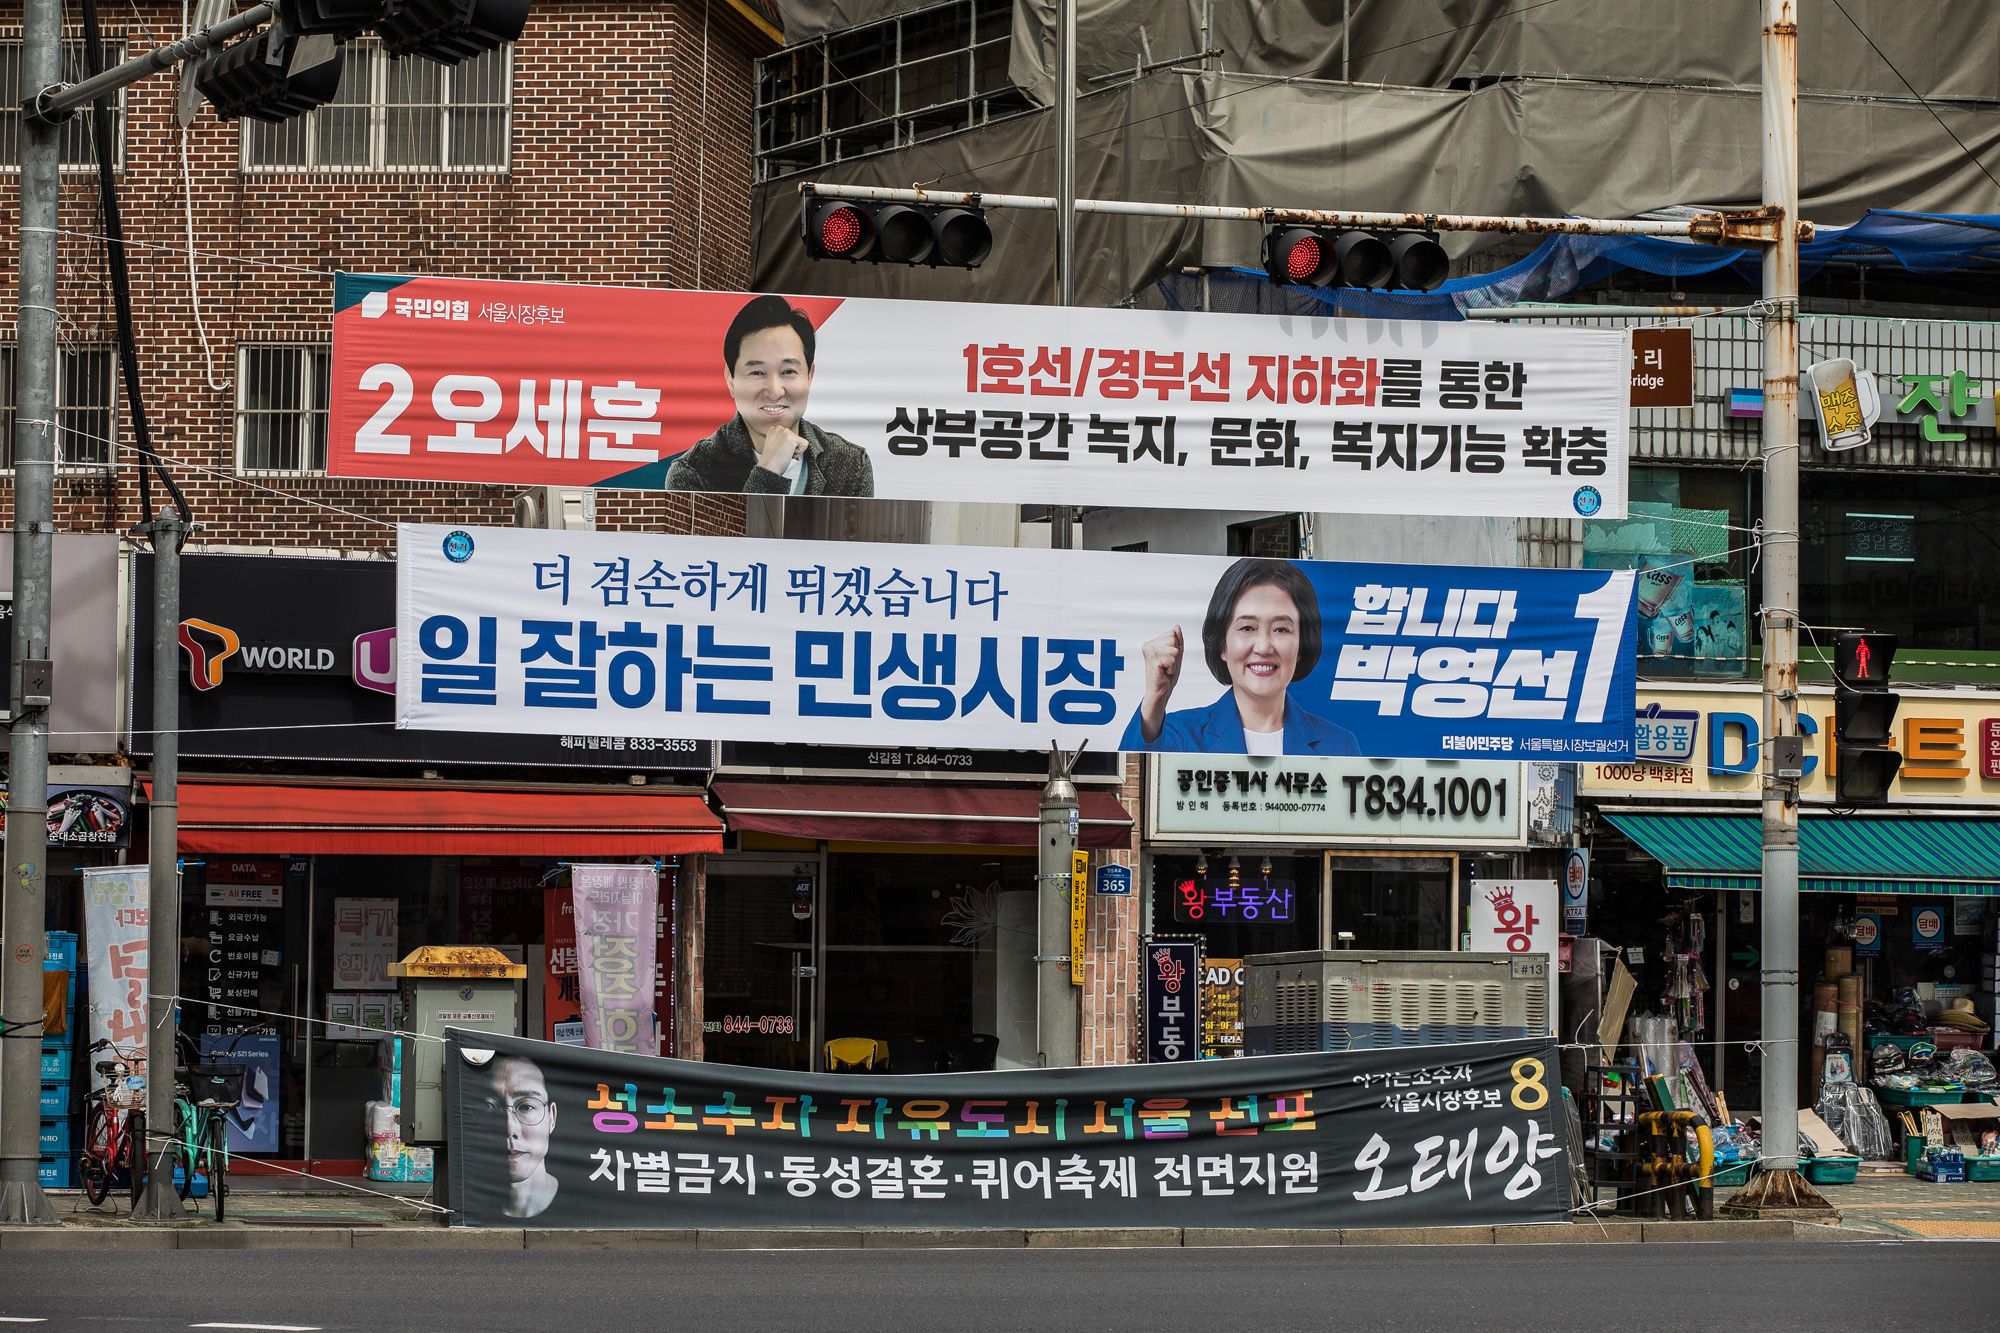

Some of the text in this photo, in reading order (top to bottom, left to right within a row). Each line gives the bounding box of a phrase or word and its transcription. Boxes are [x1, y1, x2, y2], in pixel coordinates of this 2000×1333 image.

[394, 297, 566, 326] 국민의힘 서울시장후보
[962, 342, 1528, 411] 1호선/경부선 지하화를 통한
[1820, 388, 1859, 414] 맥주
[354, 362, 662, 463] 2 오세훈
[1828, 411, 1861, 436] 소주
[885, 406, 1609, 477] 상부공간 녹지, 문화, 복지기능 확충
[1578, 496, 1596, 507] 선거
[448, 542, 468, 553] 선거
[532, 553, 1009, 621] 더 겸손하게 뛰겠습니다
[1345, 584, 1518, 639] 합니다
[1575, 569, 1630, 724] 1
[240, 645, 336, 671] WORLD
[418, 615, 1125, 726] 일 잘하는 민생시장
[1330, 643, 1579, 721] 박영선
[560, 735, 697, 752] 해피텔레콤 833-3553
[1441, 735, 1630, 754] 더불어민주당 서울특별시장보궐선거
[867, 751, 974, 767] 신길점 T.844-0733
[1594, 763, 1695, 785] 1000냥 백화점
[1177, 769, 1508, 818] 공인중개사 사무소 T834.1001
[1222, 801, 1257, 812] 등록번호
[1265, 803, 1326, 812] 9440000-07774
[48, 831, 118, 843] 순대소곱창전골
[231, 863, 257, 873] DATA
[289, 862, 307, 872] ADT
[228, 889, 239, 898] All
[240, 890, 262, 898] FREE
[795, 883, 811, 892] ADT
[1102, 879, 1126, 892] 365
[1079, 880, 1087, 929] CCTV
[1182, 887, 1293, 920] 왕부동산
[228, 914, 268, 922] 외국인가능
[338, 907, 397, 937] 특가
[1493, 903, 1540, 953] 왕
[1917, 917, 1939, 930] 담배
[227, 933, 260, 942] 요금수납
[227, 952, 260, 961] 번호이동
[337, 952, 393, 982] 행사
[227, 970, 259, 979] 신규가입
[1520, 964, 1543, 975] #13
[226, 989, 258, 998] 보상판매
[704, 1015, 794, 1034] 전화 844-0733
[1205, 1035, 1216, 1044] 5F
[247, 1050, 269, 1058] Series
[1205, 1048, 1216, 1057] 4F
[1510, 1057, 1549, 1111] 8
[1380, 1088, 1503, 1113] 서울시장후보
[587, 1082, 1317, 1142] 성소수자 자유도시 서울 선포
[1352, 1118, 1562, 1202] 오태양
[1153, 1150, 1319, 1198] 전면지원
